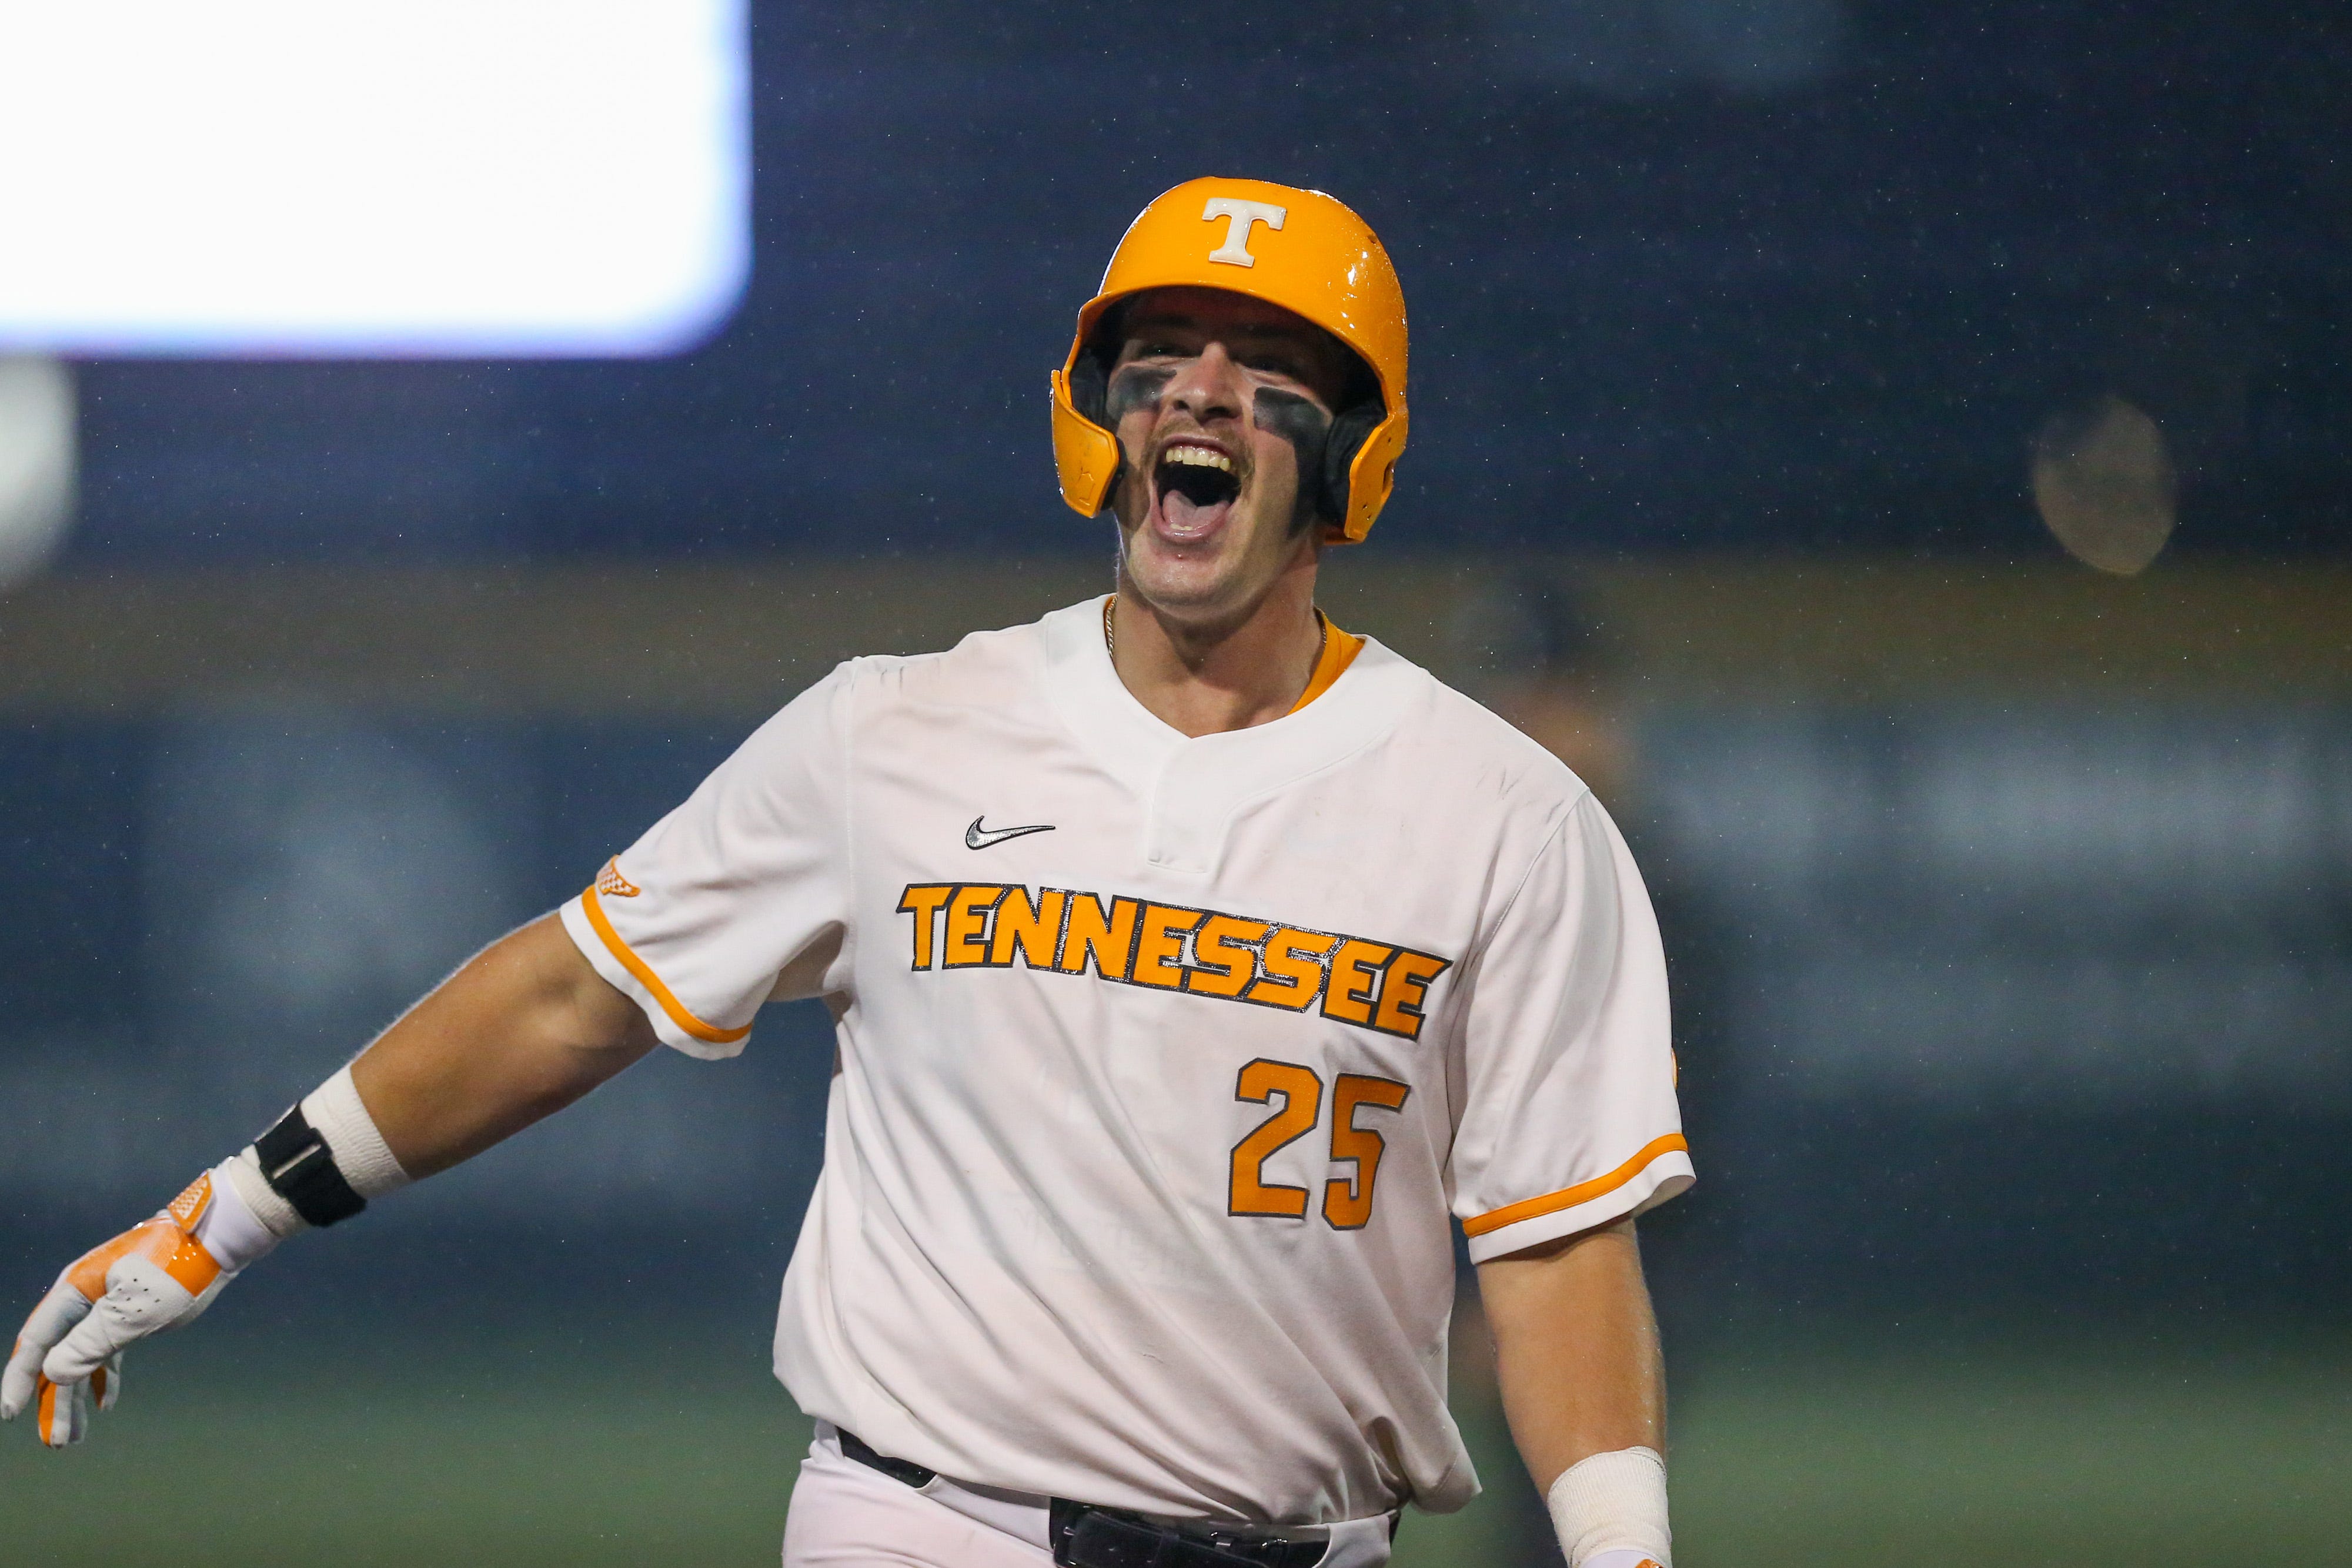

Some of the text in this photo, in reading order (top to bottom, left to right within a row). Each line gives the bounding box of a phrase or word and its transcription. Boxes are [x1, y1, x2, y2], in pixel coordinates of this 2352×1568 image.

[1202, 197, 1286, 268] T
[897, 882, 1453, 1041] TENNESSEE
[1228, 1058, 1411, 1230] 25
